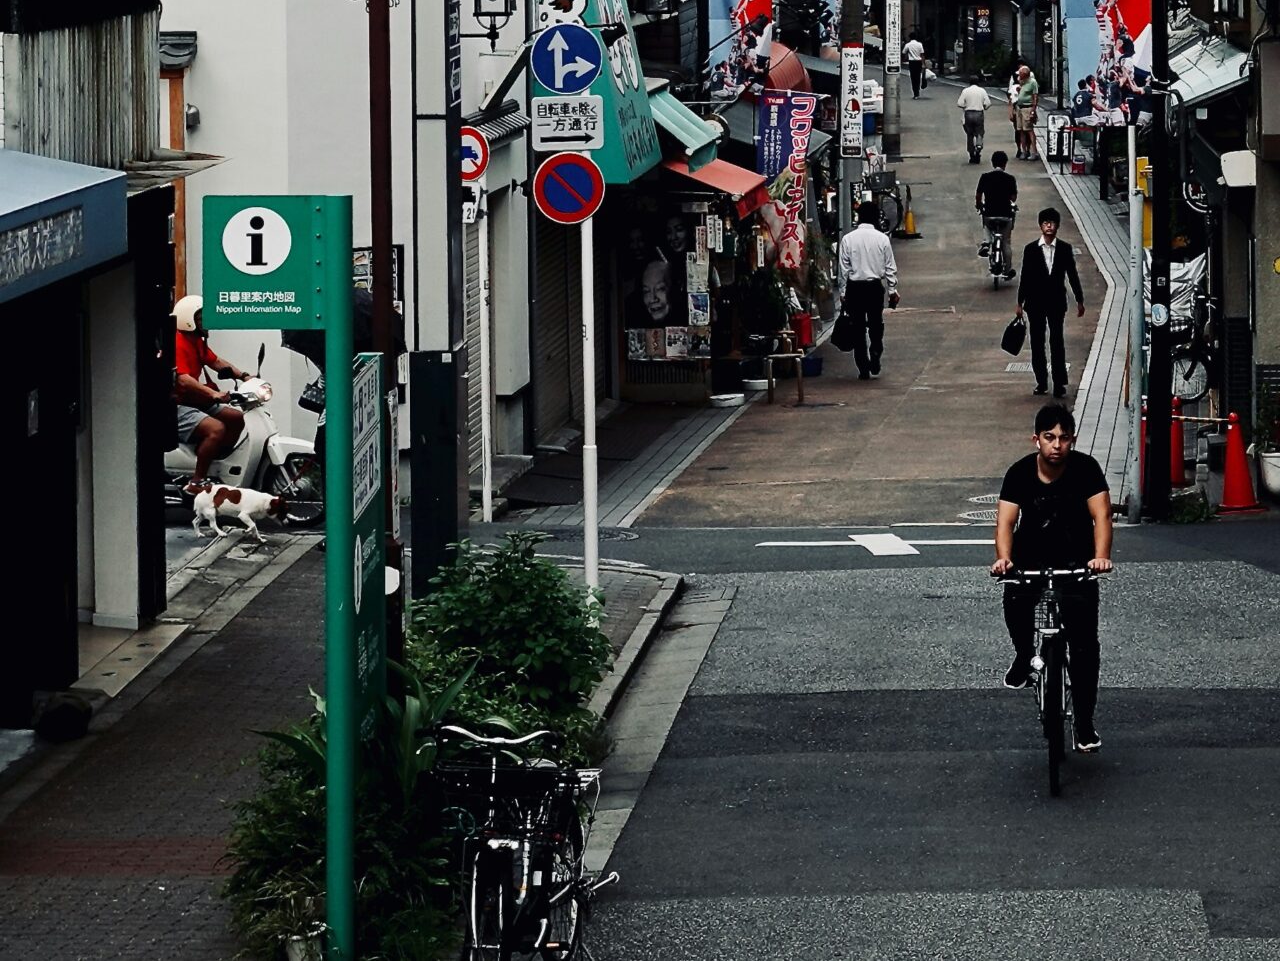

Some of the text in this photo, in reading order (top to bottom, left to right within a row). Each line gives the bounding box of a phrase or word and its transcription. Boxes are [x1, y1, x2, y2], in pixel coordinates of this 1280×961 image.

[847, 61, 859, 96] かき氷
[537, 103, 597, 117] 自転車を除く
[537, 118, 597, 132] 一方通行
[219, 291, 295, 303] 日暮里案内地図
[216, 305, 243, 314] Nippori
[284, 305, 302, 314] Map
